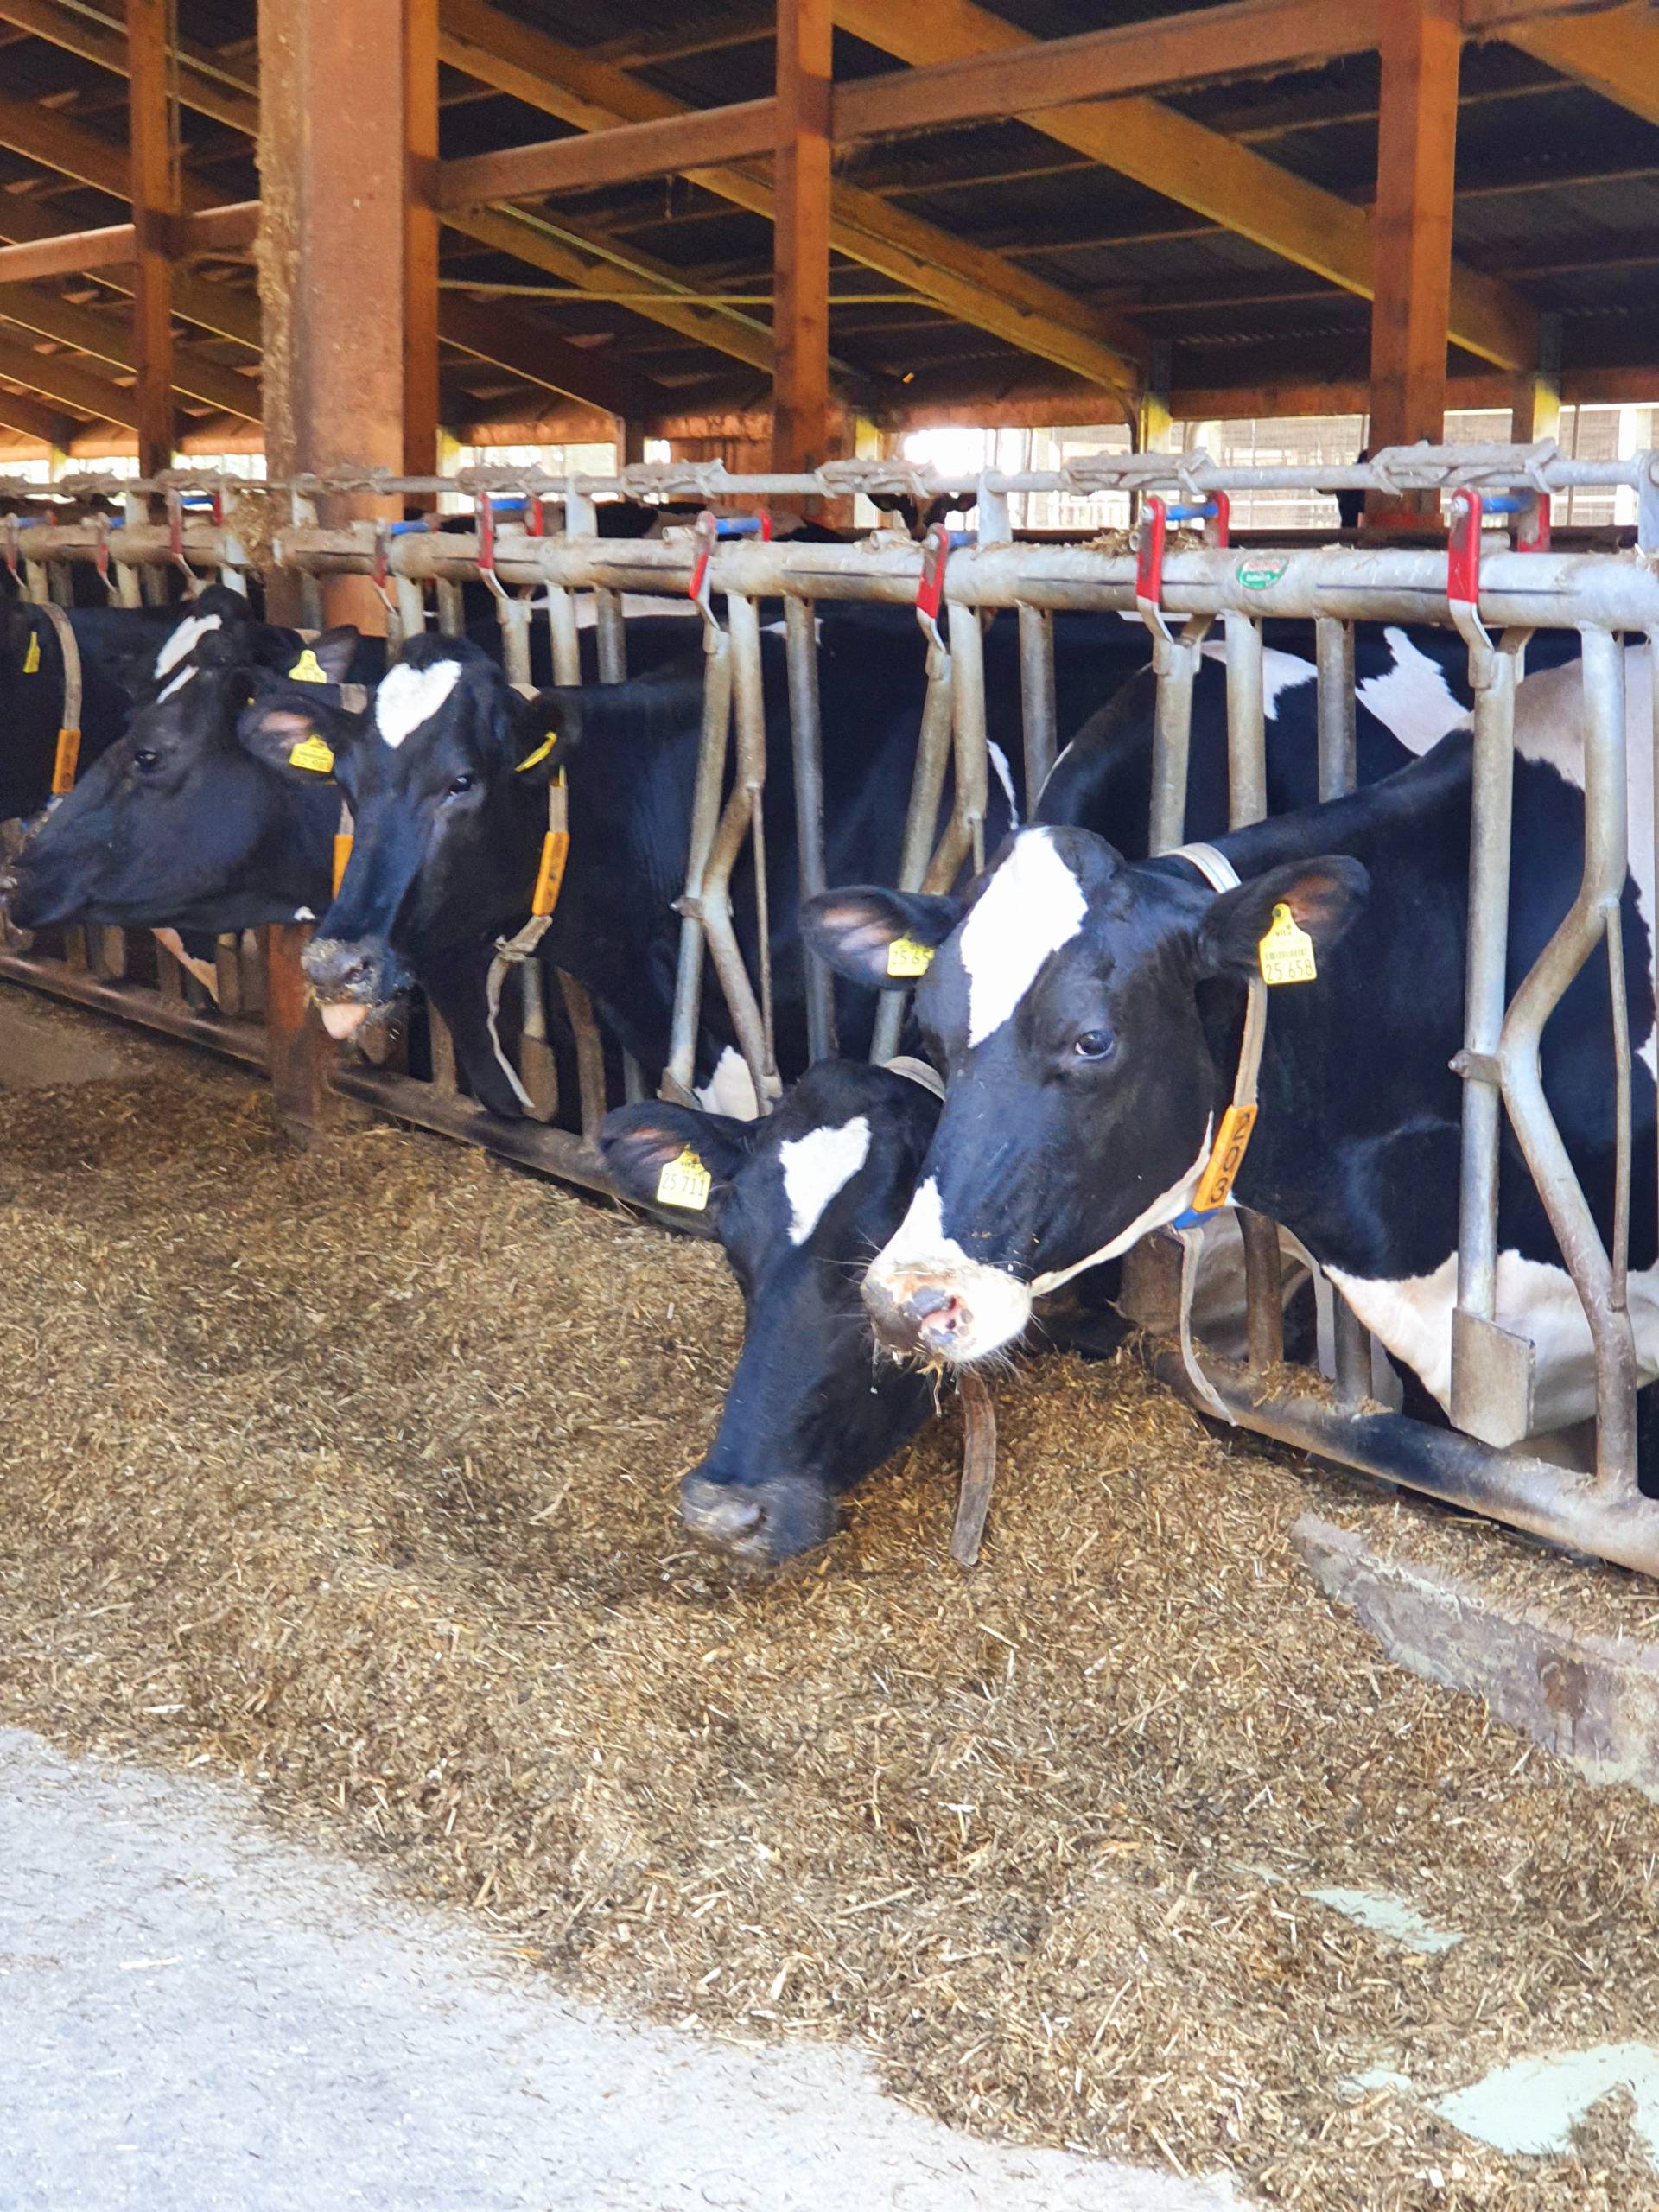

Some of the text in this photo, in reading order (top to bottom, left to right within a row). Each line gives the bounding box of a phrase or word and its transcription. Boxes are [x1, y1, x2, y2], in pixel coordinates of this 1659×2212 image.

[1265, 958, 1313, 982] 25 658
[1210, 1112, 1251, 1204] 203
[662, 1172, 677, 1191] 25
[682, 1175, 706, 1197] 711
